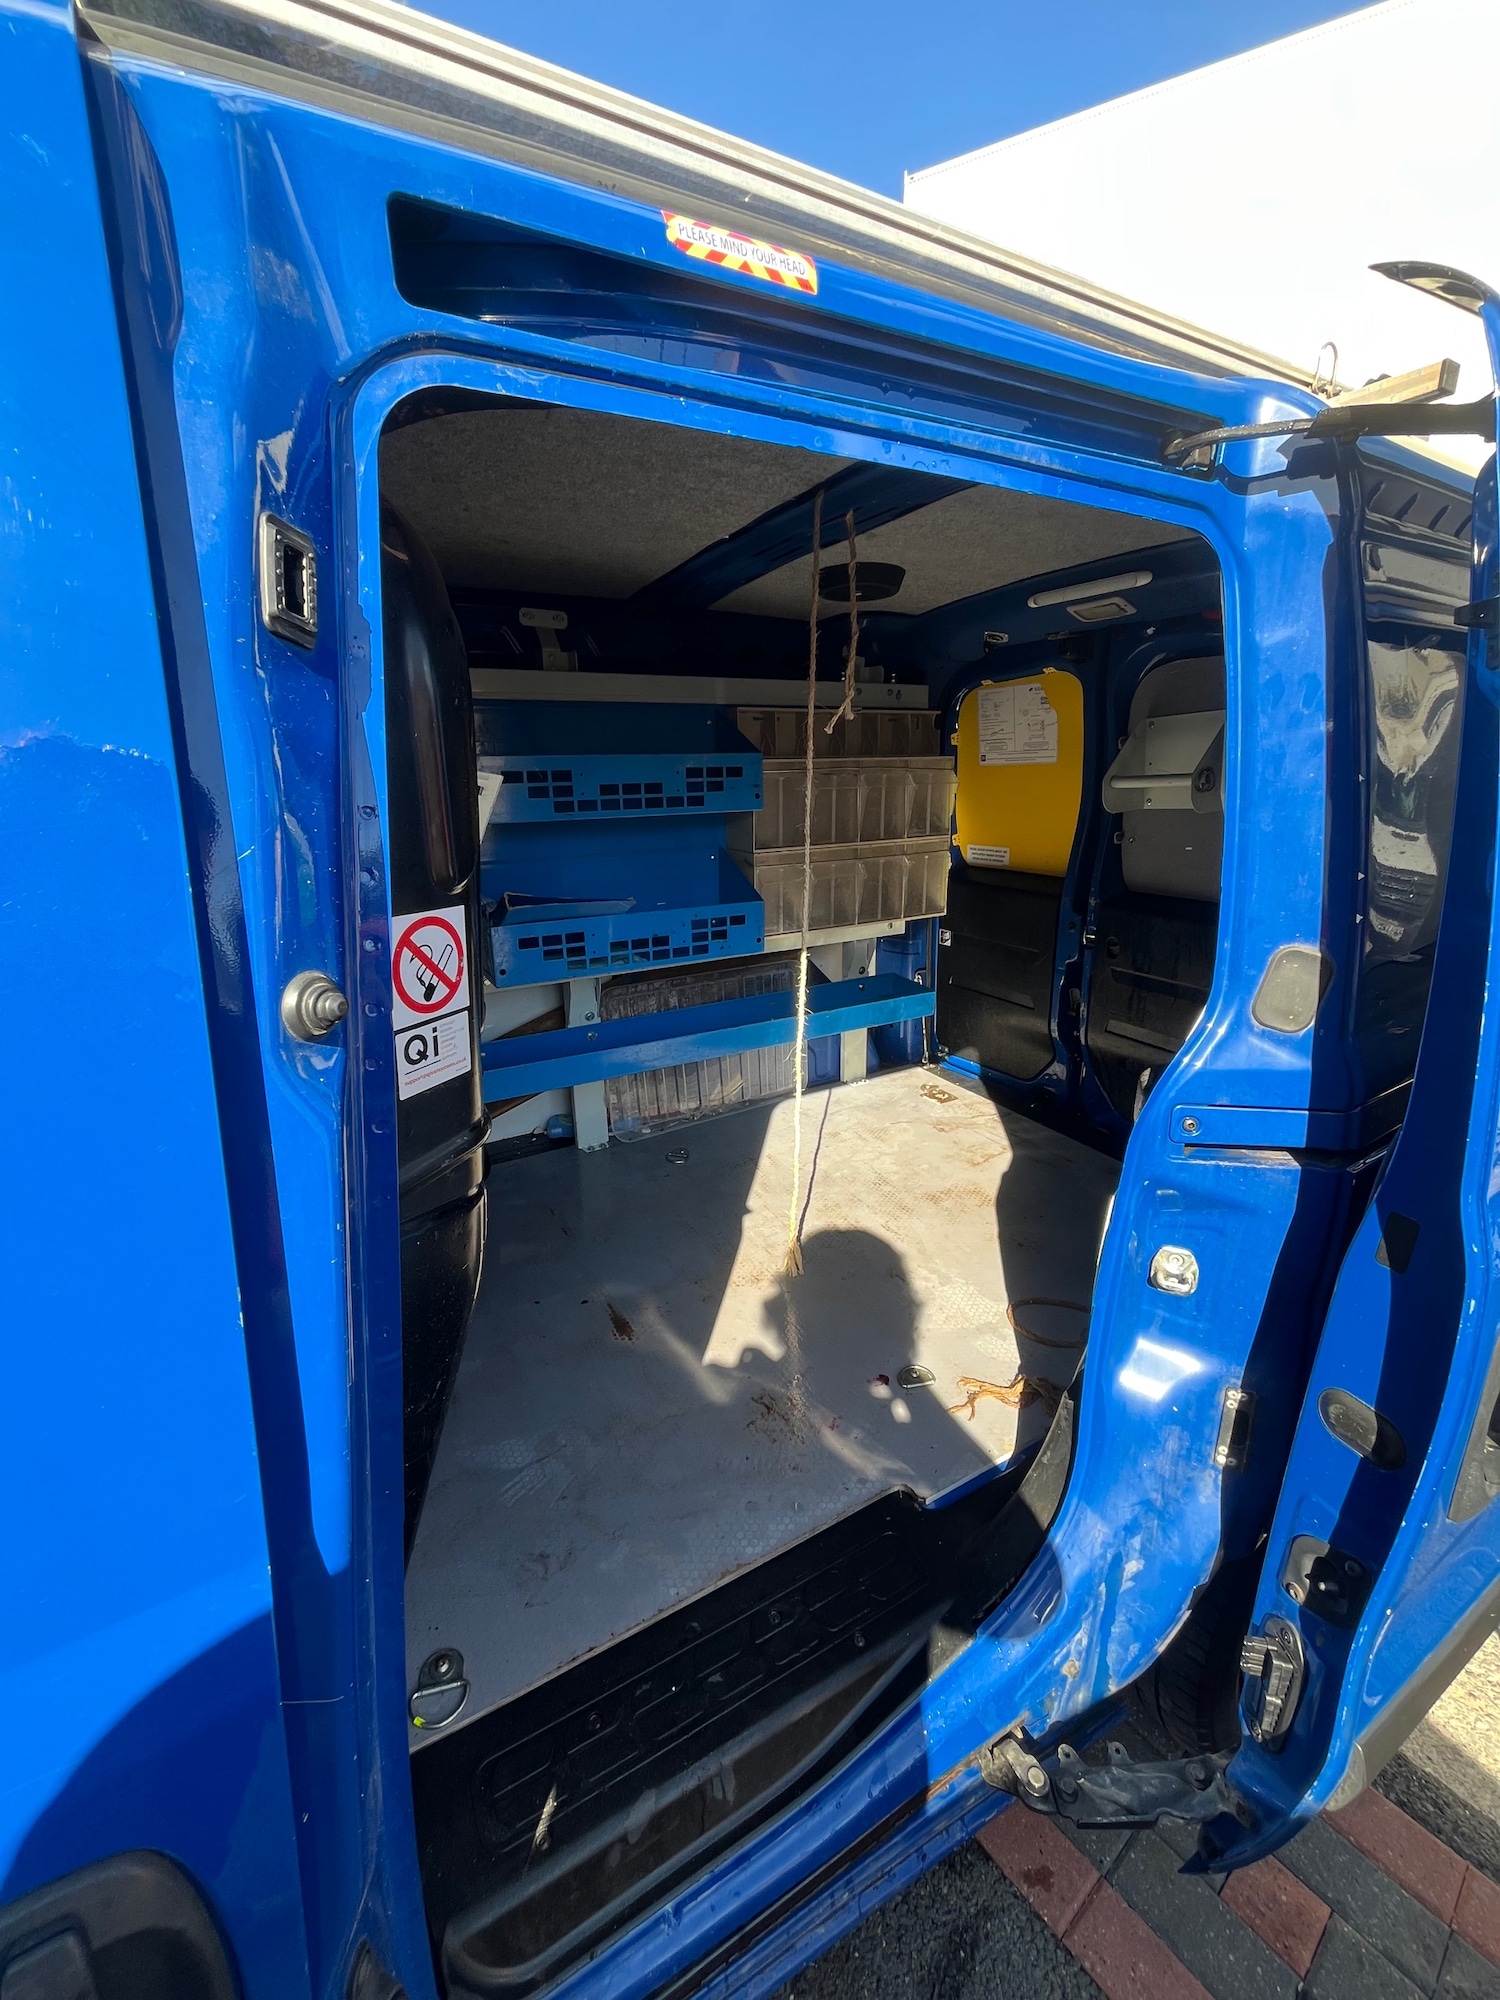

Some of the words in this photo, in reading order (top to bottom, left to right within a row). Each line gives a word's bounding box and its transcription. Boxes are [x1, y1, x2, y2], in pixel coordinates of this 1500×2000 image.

[678, 223, 717, 248] PLEASE
[720, 237, 748, 257] MIND
[751, 247, 777, 266] YOUR
[779, 258, 806, 276] HEAD
[404, 1026, 439, 1066] Qi
